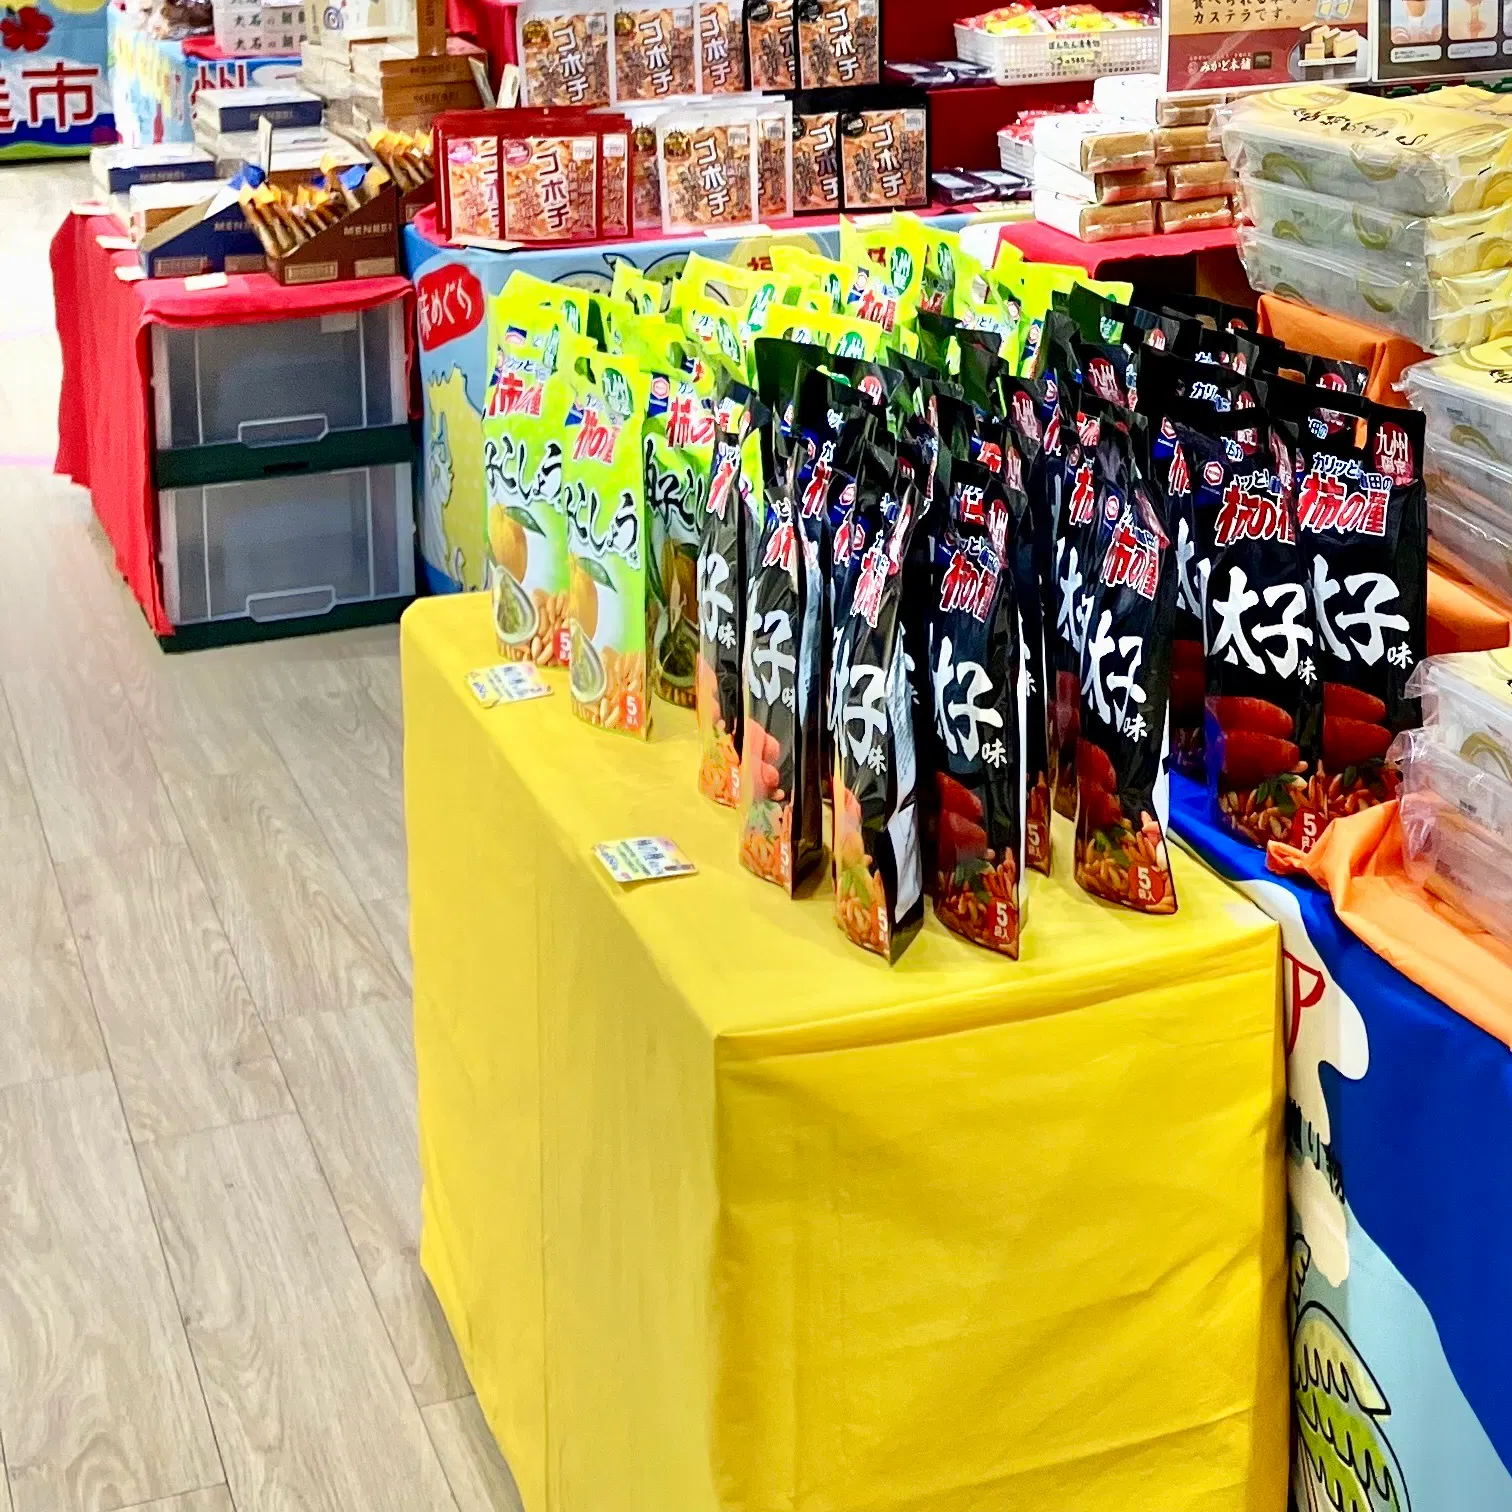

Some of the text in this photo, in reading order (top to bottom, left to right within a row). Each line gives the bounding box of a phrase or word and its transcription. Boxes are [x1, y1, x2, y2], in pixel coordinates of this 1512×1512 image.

[1193, 6, 1292, 25] カステラです。
[1299, 473, 1390, 536] 柿の種
